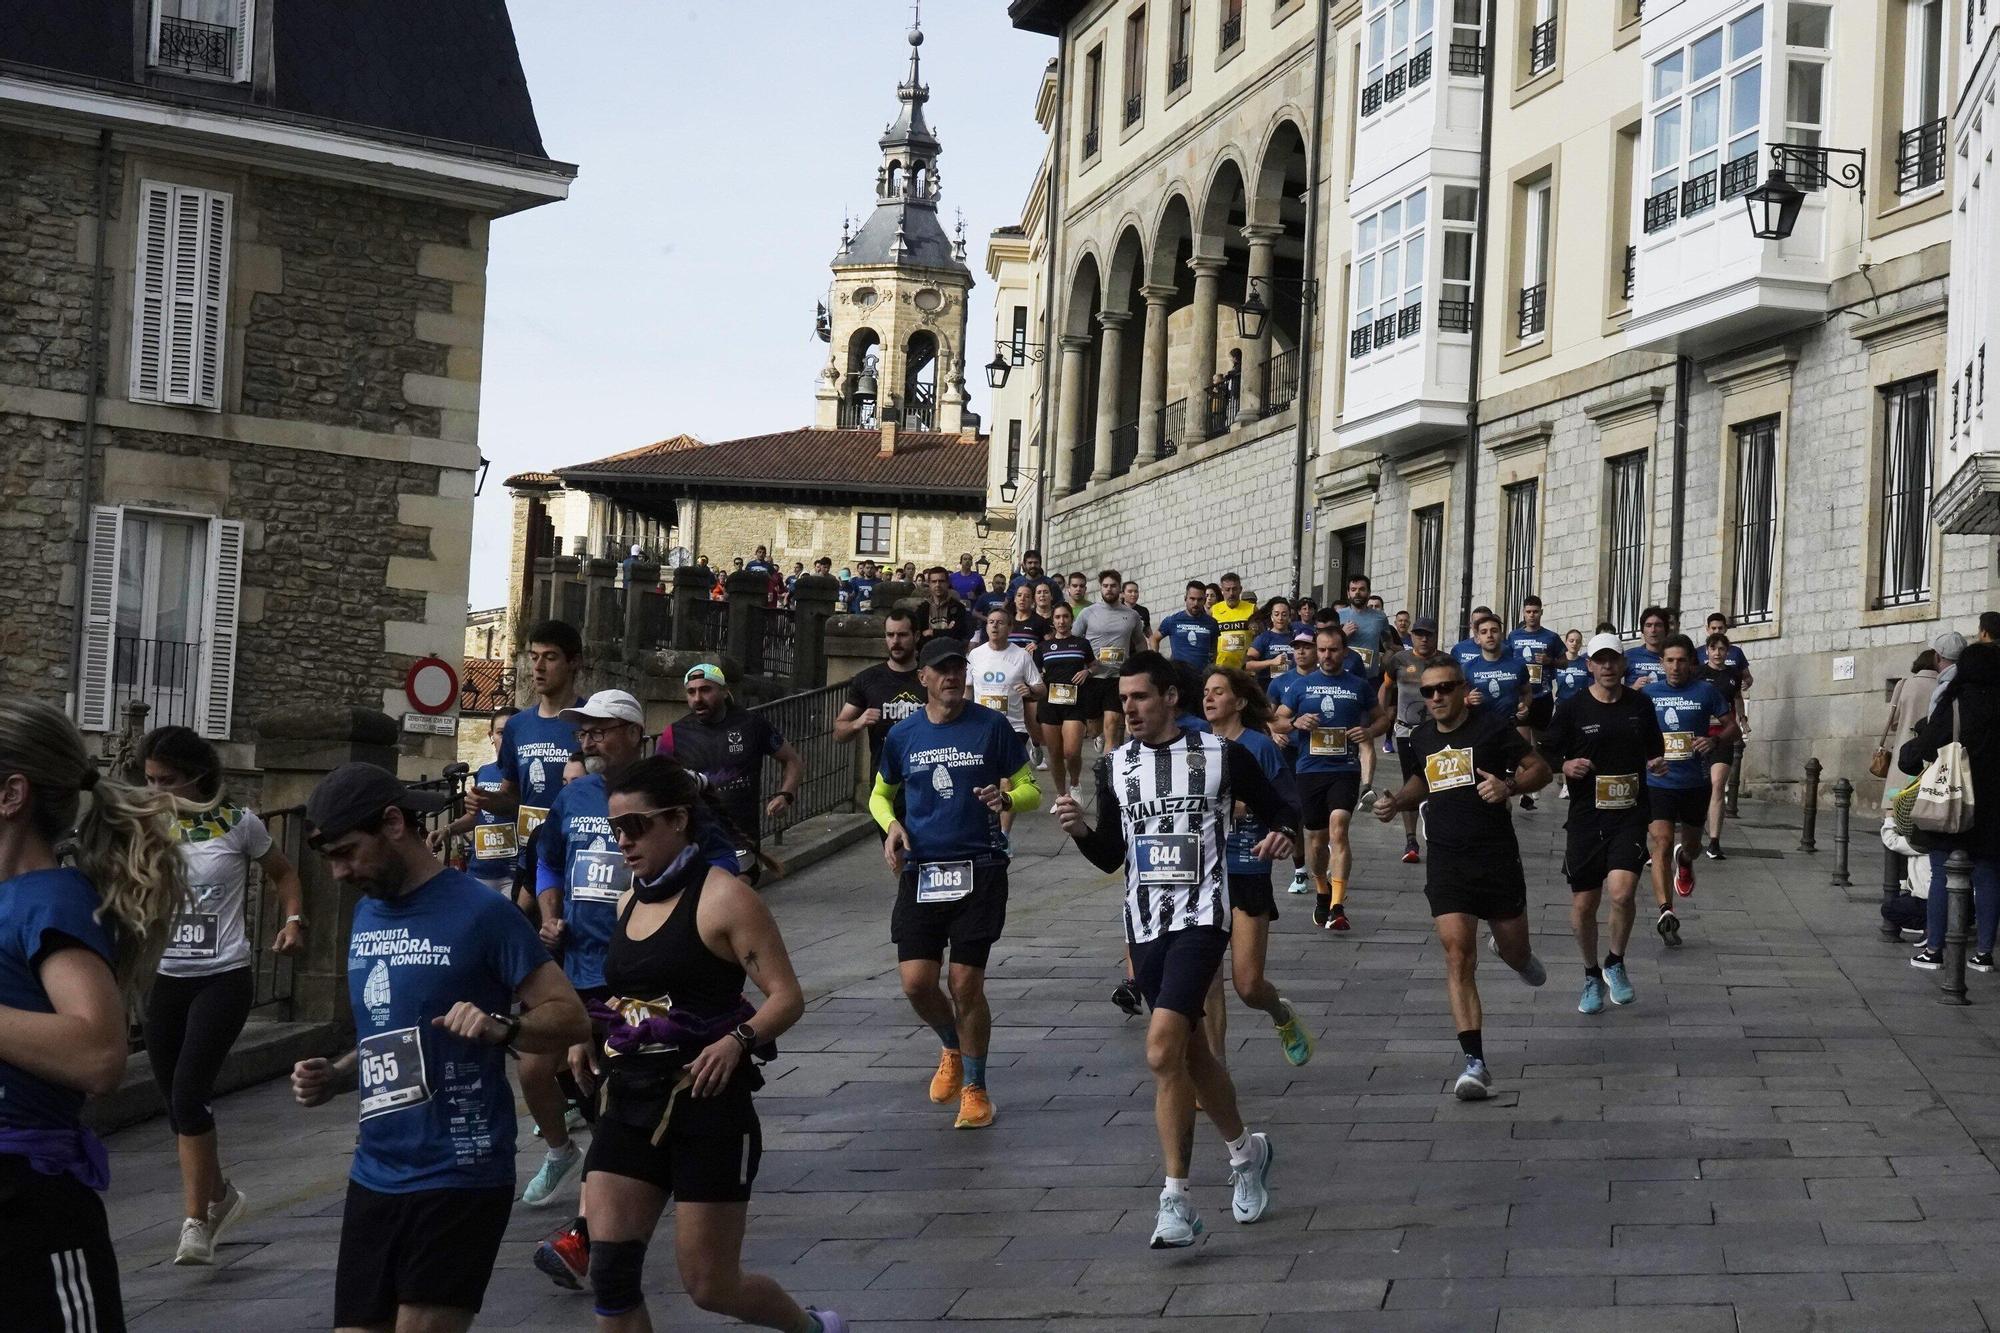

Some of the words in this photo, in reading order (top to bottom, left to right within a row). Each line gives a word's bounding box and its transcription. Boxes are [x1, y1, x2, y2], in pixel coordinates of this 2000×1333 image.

[983, 671, 1006, 683] OD
[1323, 734, 1334, 745] 41
[1665, 738, 1685, 750] 245
[523, 742, 555, 751] CONQUISTA
[729, 744, 744, 753] OTSO
[917, 746, 958, 757] CONQUISTA
[522, 748, 568, 758] ALMENDRA
[919, 751, 974, 765] ALMENDRA
[947, 759, 984, 768] KONKISTA
[1436, 757, 1460, 776] 222
[1608, 783, 1631, 797] 602
[570, 816, 578, 824] LA
[577, 816, 610, 824] CONQU
[483, 832, 505, 847] 665
[1149, 846, 1181, 865] 844
[587, 863, 614, 883] 911
[928, 870, 962, 888] 1083
[358, 928, 409, 942] CONQUISTA
[355, 938, 432, 957] ALMENDRA
[432, 945, 451, 953] REN
[390, 954, 451, 966] KONKISTA
[402, 1035, 413, 1043] 5K
[361, 1051, 399, 1088] 855
